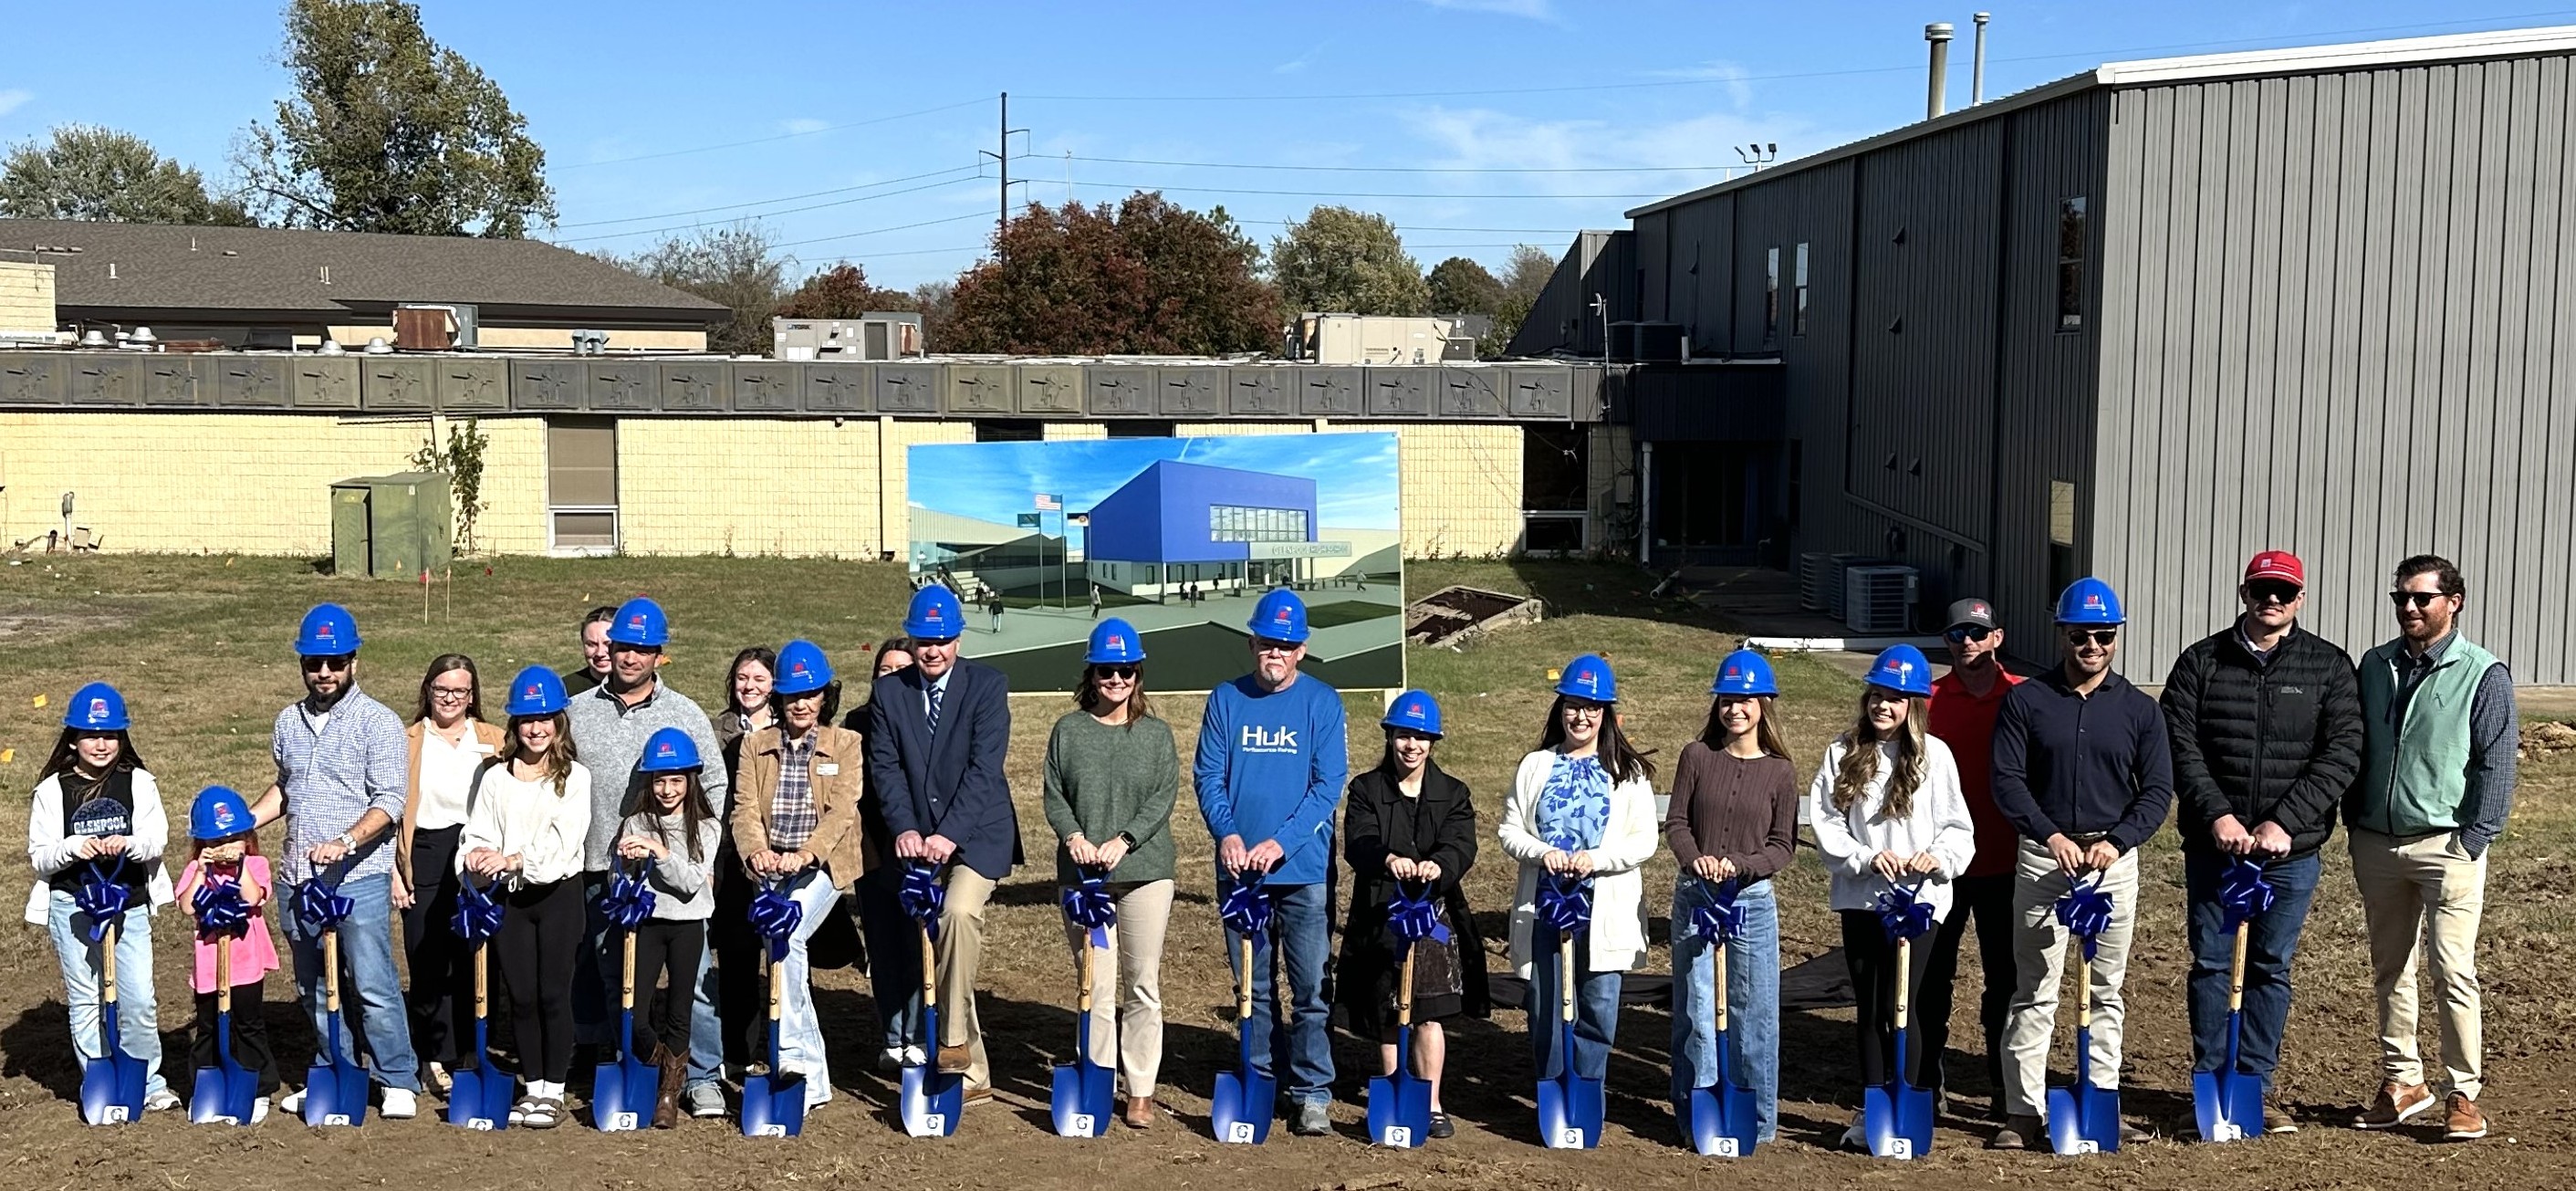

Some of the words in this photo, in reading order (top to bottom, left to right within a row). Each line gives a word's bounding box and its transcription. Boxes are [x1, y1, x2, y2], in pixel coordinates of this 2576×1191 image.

[1242, 725, 1298, 747] Huk
[73, 815, 127, 834] GLENPOOL
[110, 1107, 122, 1121] G
[619, 1114, 631, 1127] G
[926, 1115, 939, 1129] G
[1076, 1115, 1088, 1130] G
[1236, 1124, 1248, 1138] G
[1392, 1128, 1404, 1143] G
[1565, 1129, 1576, 1144] G
[1719, 1139, 1732, 1154] G
[1892, 1140, 1904, 1154] G
